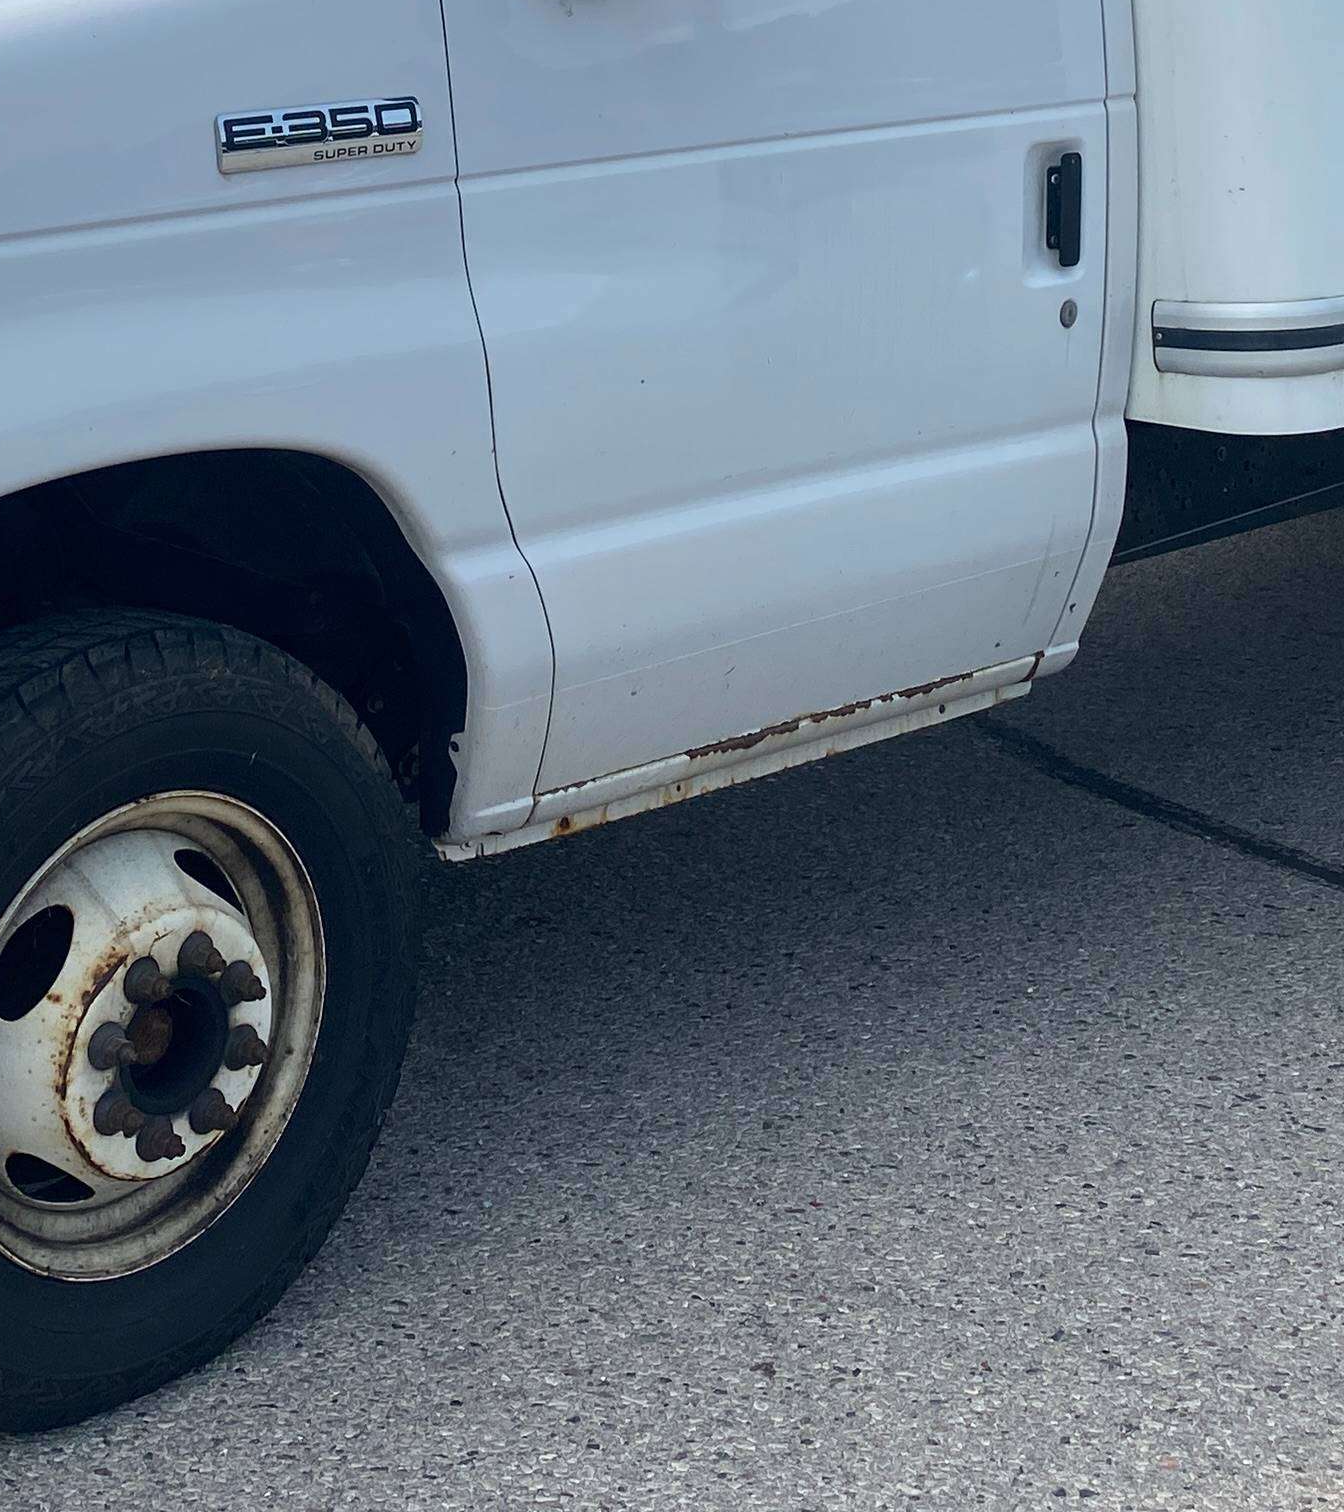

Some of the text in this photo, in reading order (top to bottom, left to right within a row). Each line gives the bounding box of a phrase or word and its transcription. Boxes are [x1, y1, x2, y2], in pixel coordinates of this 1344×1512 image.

[221, 99, 419, 153] E-350
[313, 140, 417, 161] SUPER DUTY
